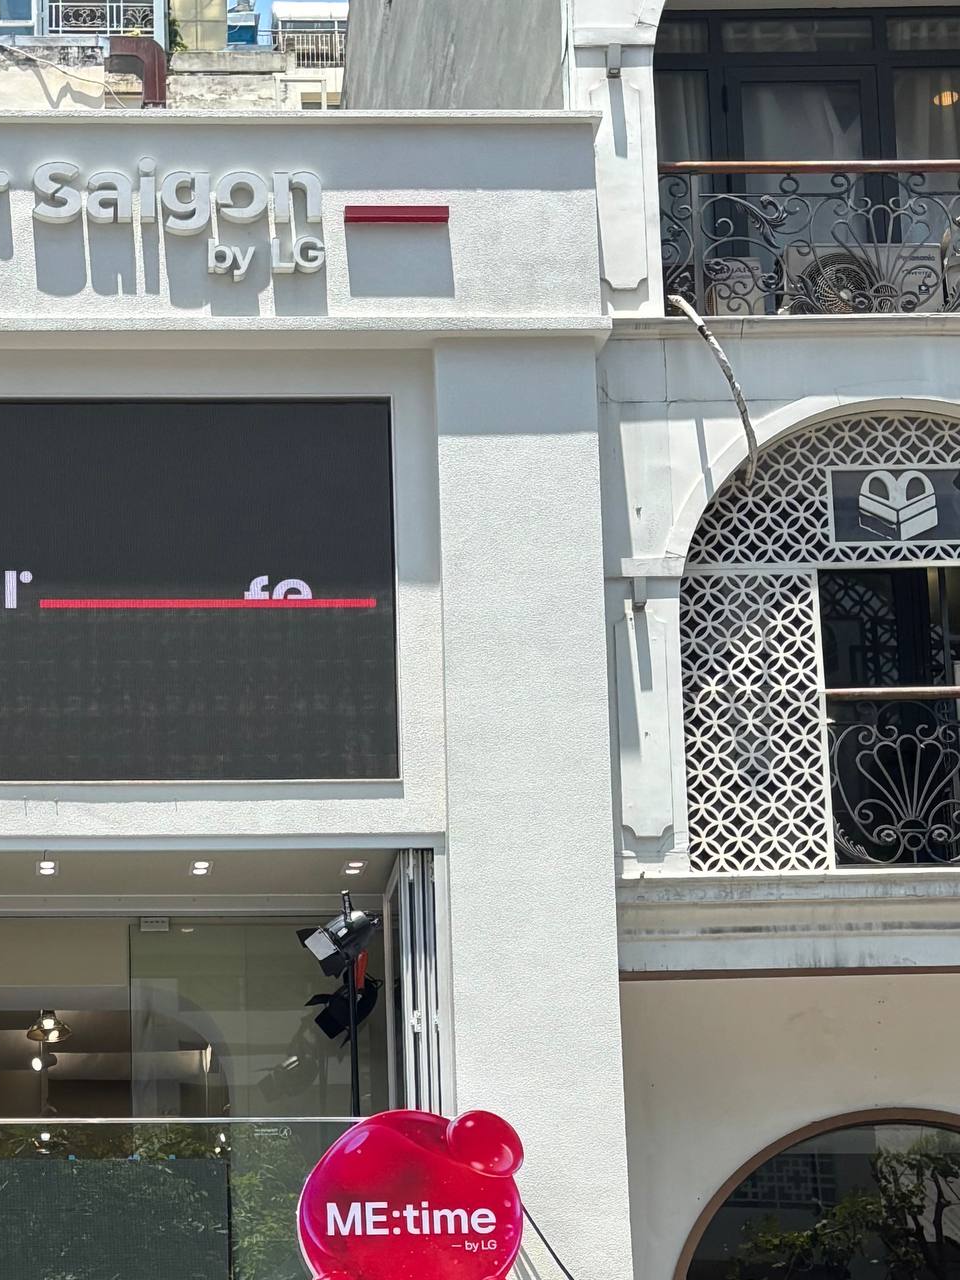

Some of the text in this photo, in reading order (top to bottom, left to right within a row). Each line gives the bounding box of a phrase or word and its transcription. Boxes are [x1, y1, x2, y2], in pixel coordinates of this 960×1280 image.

[31, 157, 323, 236] Saigon
[207, 238, 326, 281] by LG
[325, 1200, 497, 1237] ME:time
[465, 1240, 498, 1253] by LG
